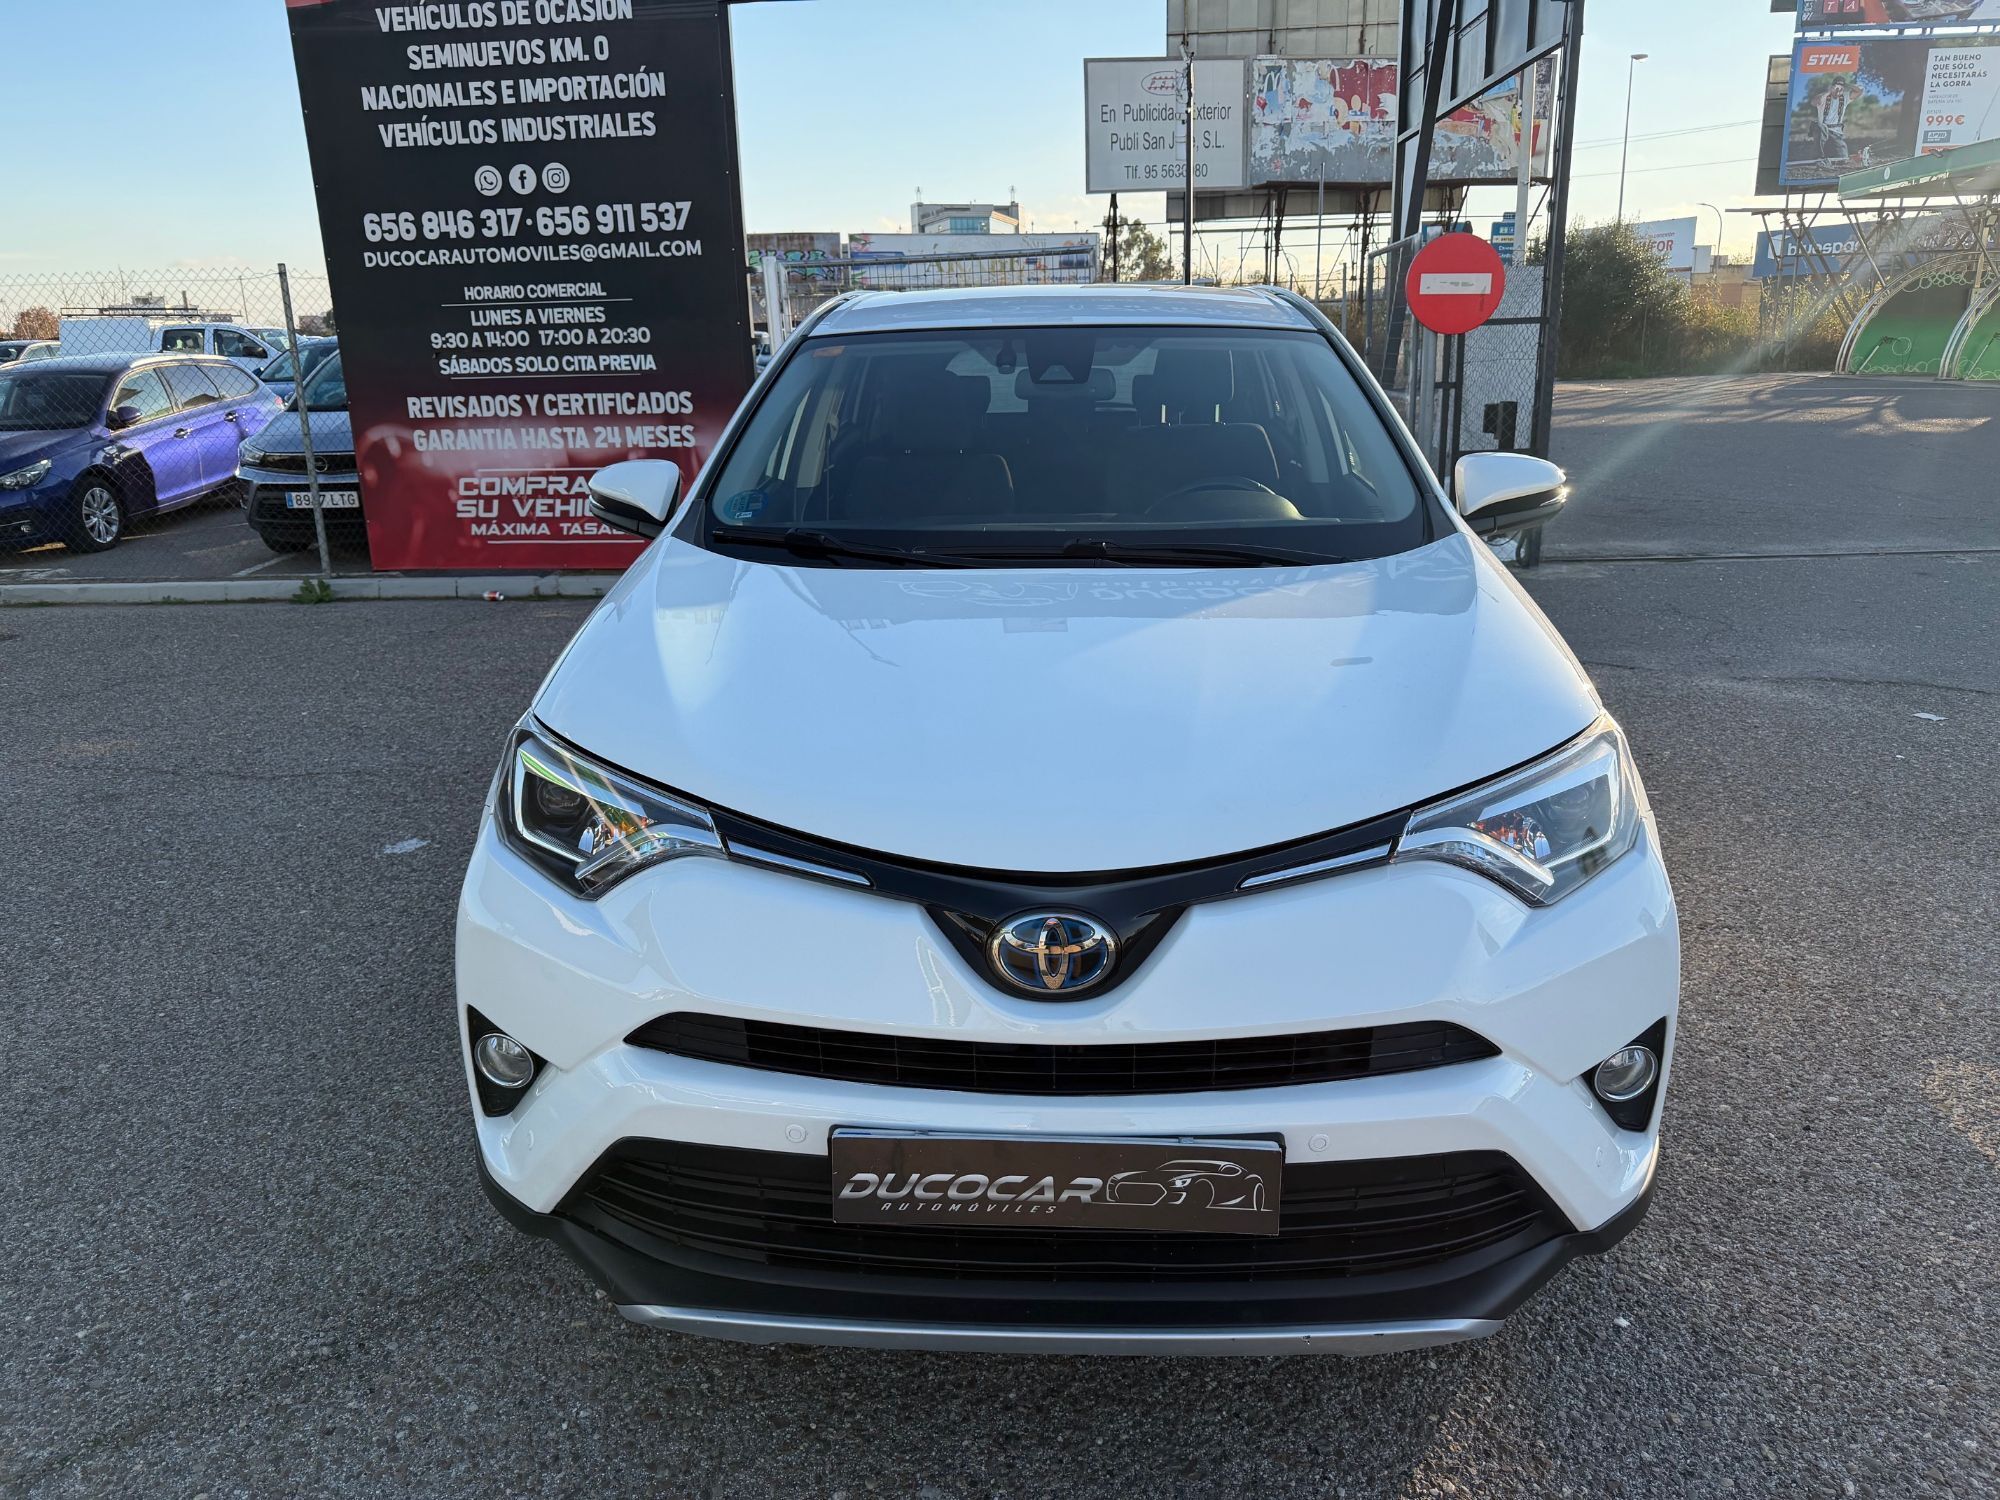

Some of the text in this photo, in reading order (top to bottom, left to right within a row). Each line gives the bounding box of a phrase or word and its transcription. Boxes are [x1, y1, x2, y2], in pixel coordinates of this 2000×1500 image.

[375, 0, 497, 32] VEHÍCULOS
[502, 0, 531, 26] DE
[406, 39, 546, 70] SEMINUEVOS
[550, 36, 589, 63] KM.
[1806, 53, 1853, 65] STIHL
[361, 65, 666, 111] NACIONALES E IMPORTACIÓN
[1101, 104, 1116, 122] En
[1926, 114, 1965, 126] 999€
[379, 111, 656, 148] VEHÍCULOS INDUSTRIALES
[1110, 132, 1139, 151] Publi
[1143, 132, 1165, 150] San
[1203, 130, 1224, 149] S.L.
[1124, 165, 1141, 179] Tlf.
[1144, 164, 1158, 178] 95
[363, 211, 417, 242] 656
[421, 209, 475, 240] 846
[480, 207, 523, 238] 317
[536, 205, 591, 237] 656
[595, 203, 636, 234] 911
[640, 201, 692, 232] 537
[363, 240, 702, 268] DUCOCARAUTOMOVILES@GMAIL.COM
[464, 282, 607, 300] HORARIO COMERCIAL
[470, 306, 606, 326] LUNES A VIERNES
[430, 327, 651, 349] 9:30 A 14:00 17:00 A 20:30
[438, 354, 657, 375] SÁBADOS SOLO CITA PREVIA
[406, 391, 694, 419] REVISADOS Y CERTIFICADOS
[520, 426, 590, 450] HASTA
[594, 426, 622, 448] 24
[625, 425, 696, 449] MESES
[458, 476, 591, 496] COMPRA
[295, 494, 356, 506] 897 LTG
[456, 498, 596, 518] SU VEHI
[471, 520, 624, 536] MÁXIMA TASA
[838, 1173, 1104, 1203] DUCOCAR
[880, 1202, 1057, 1214] AUTOMÓVILES
